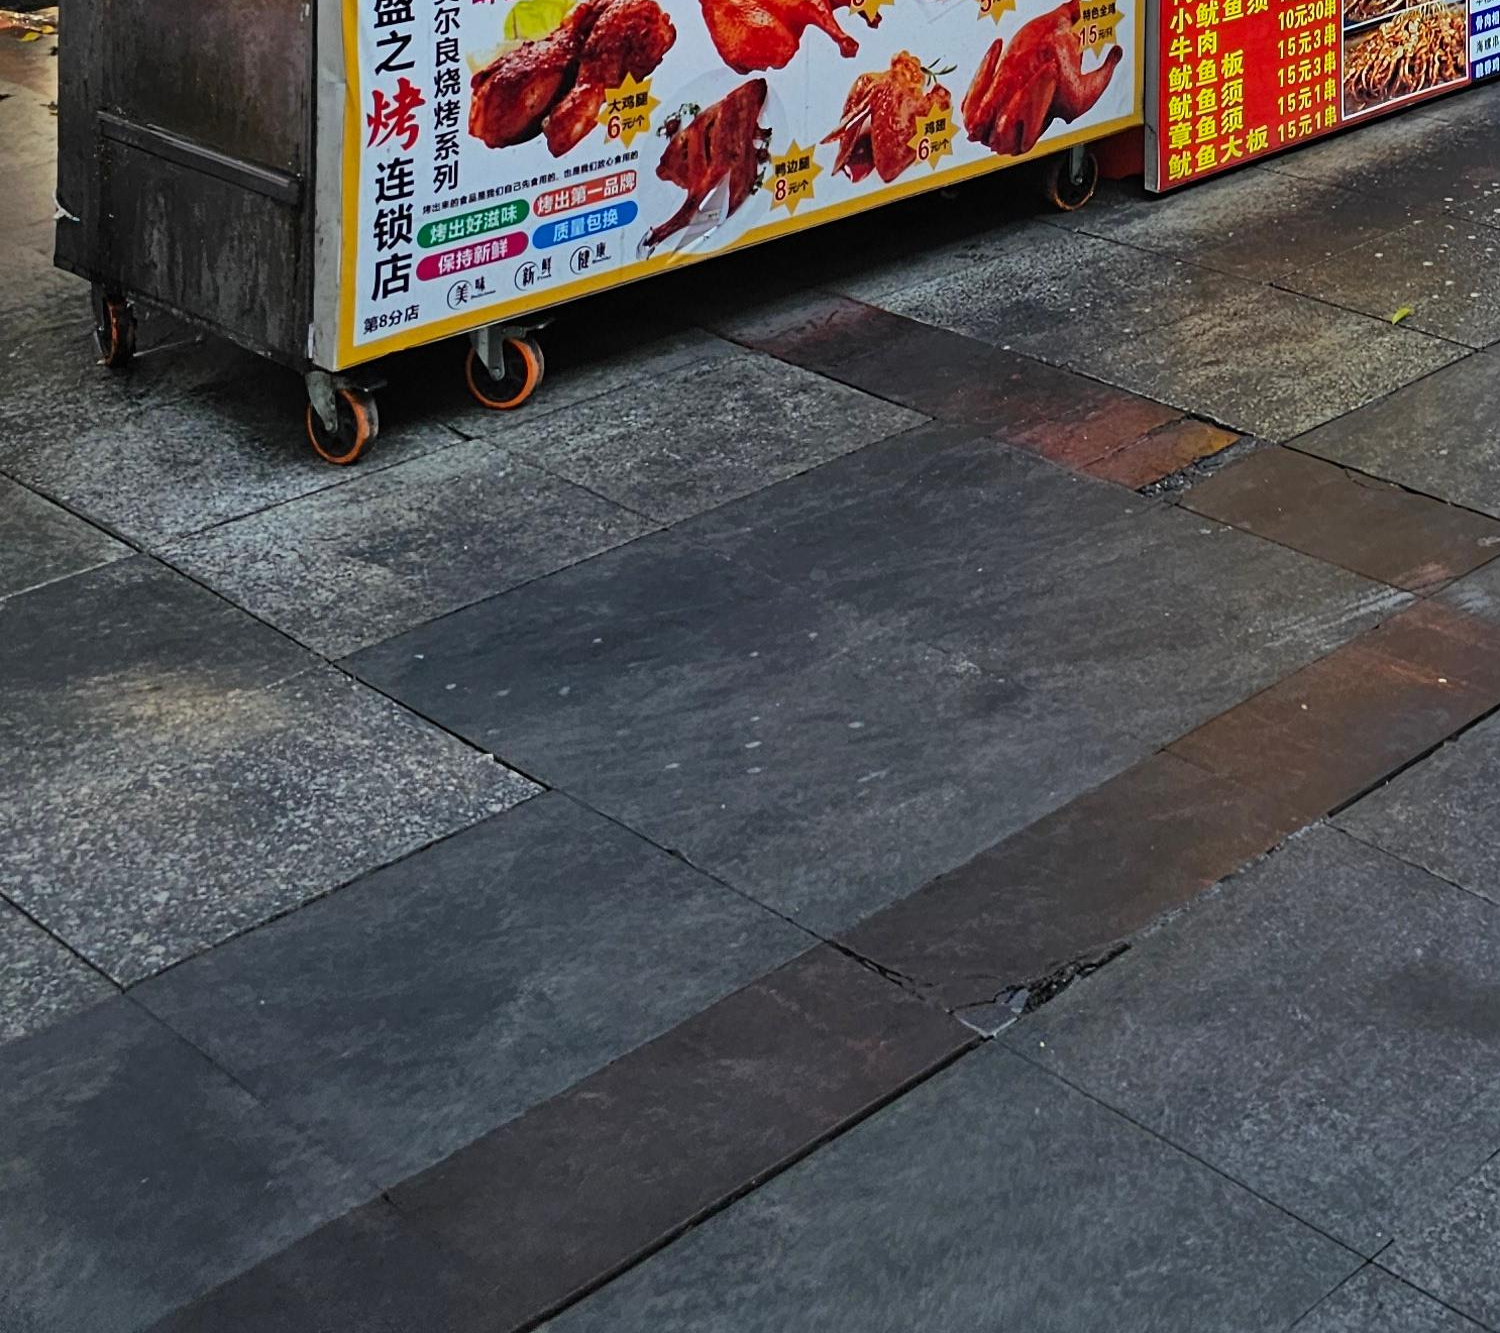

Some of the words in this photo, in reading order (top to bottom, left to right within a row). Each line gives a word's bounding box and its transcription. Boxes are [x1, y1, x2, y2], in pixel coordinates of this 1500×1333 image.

[1168, 51, 1245, 93] 鱿鱼板
[1277, 23, 1338, 59] 15元3串
[1169, 30, 1219, 64] 牛肉
[1168, 79, 1245, 122] 鱿鱼须
[1277, 51, 1338, 88] 15元3串
[1168, 107, 1245, 150] 章鱼须
[1277, 79, 1338, 116] 15元1串
[1168, 126, 1269, 181] 鱿鱼大板
[1277, 107, 1338, 144] 15元1串
[429, 204, 518, 244] 烤出好滋味
[536, 172, 636, 215] 烤出第一品牌
[438, 237, 509, 276] 保持新鲜
[552, 210, 619, 243] 质量包换
[363, 303, 420, 334] 第8分店
